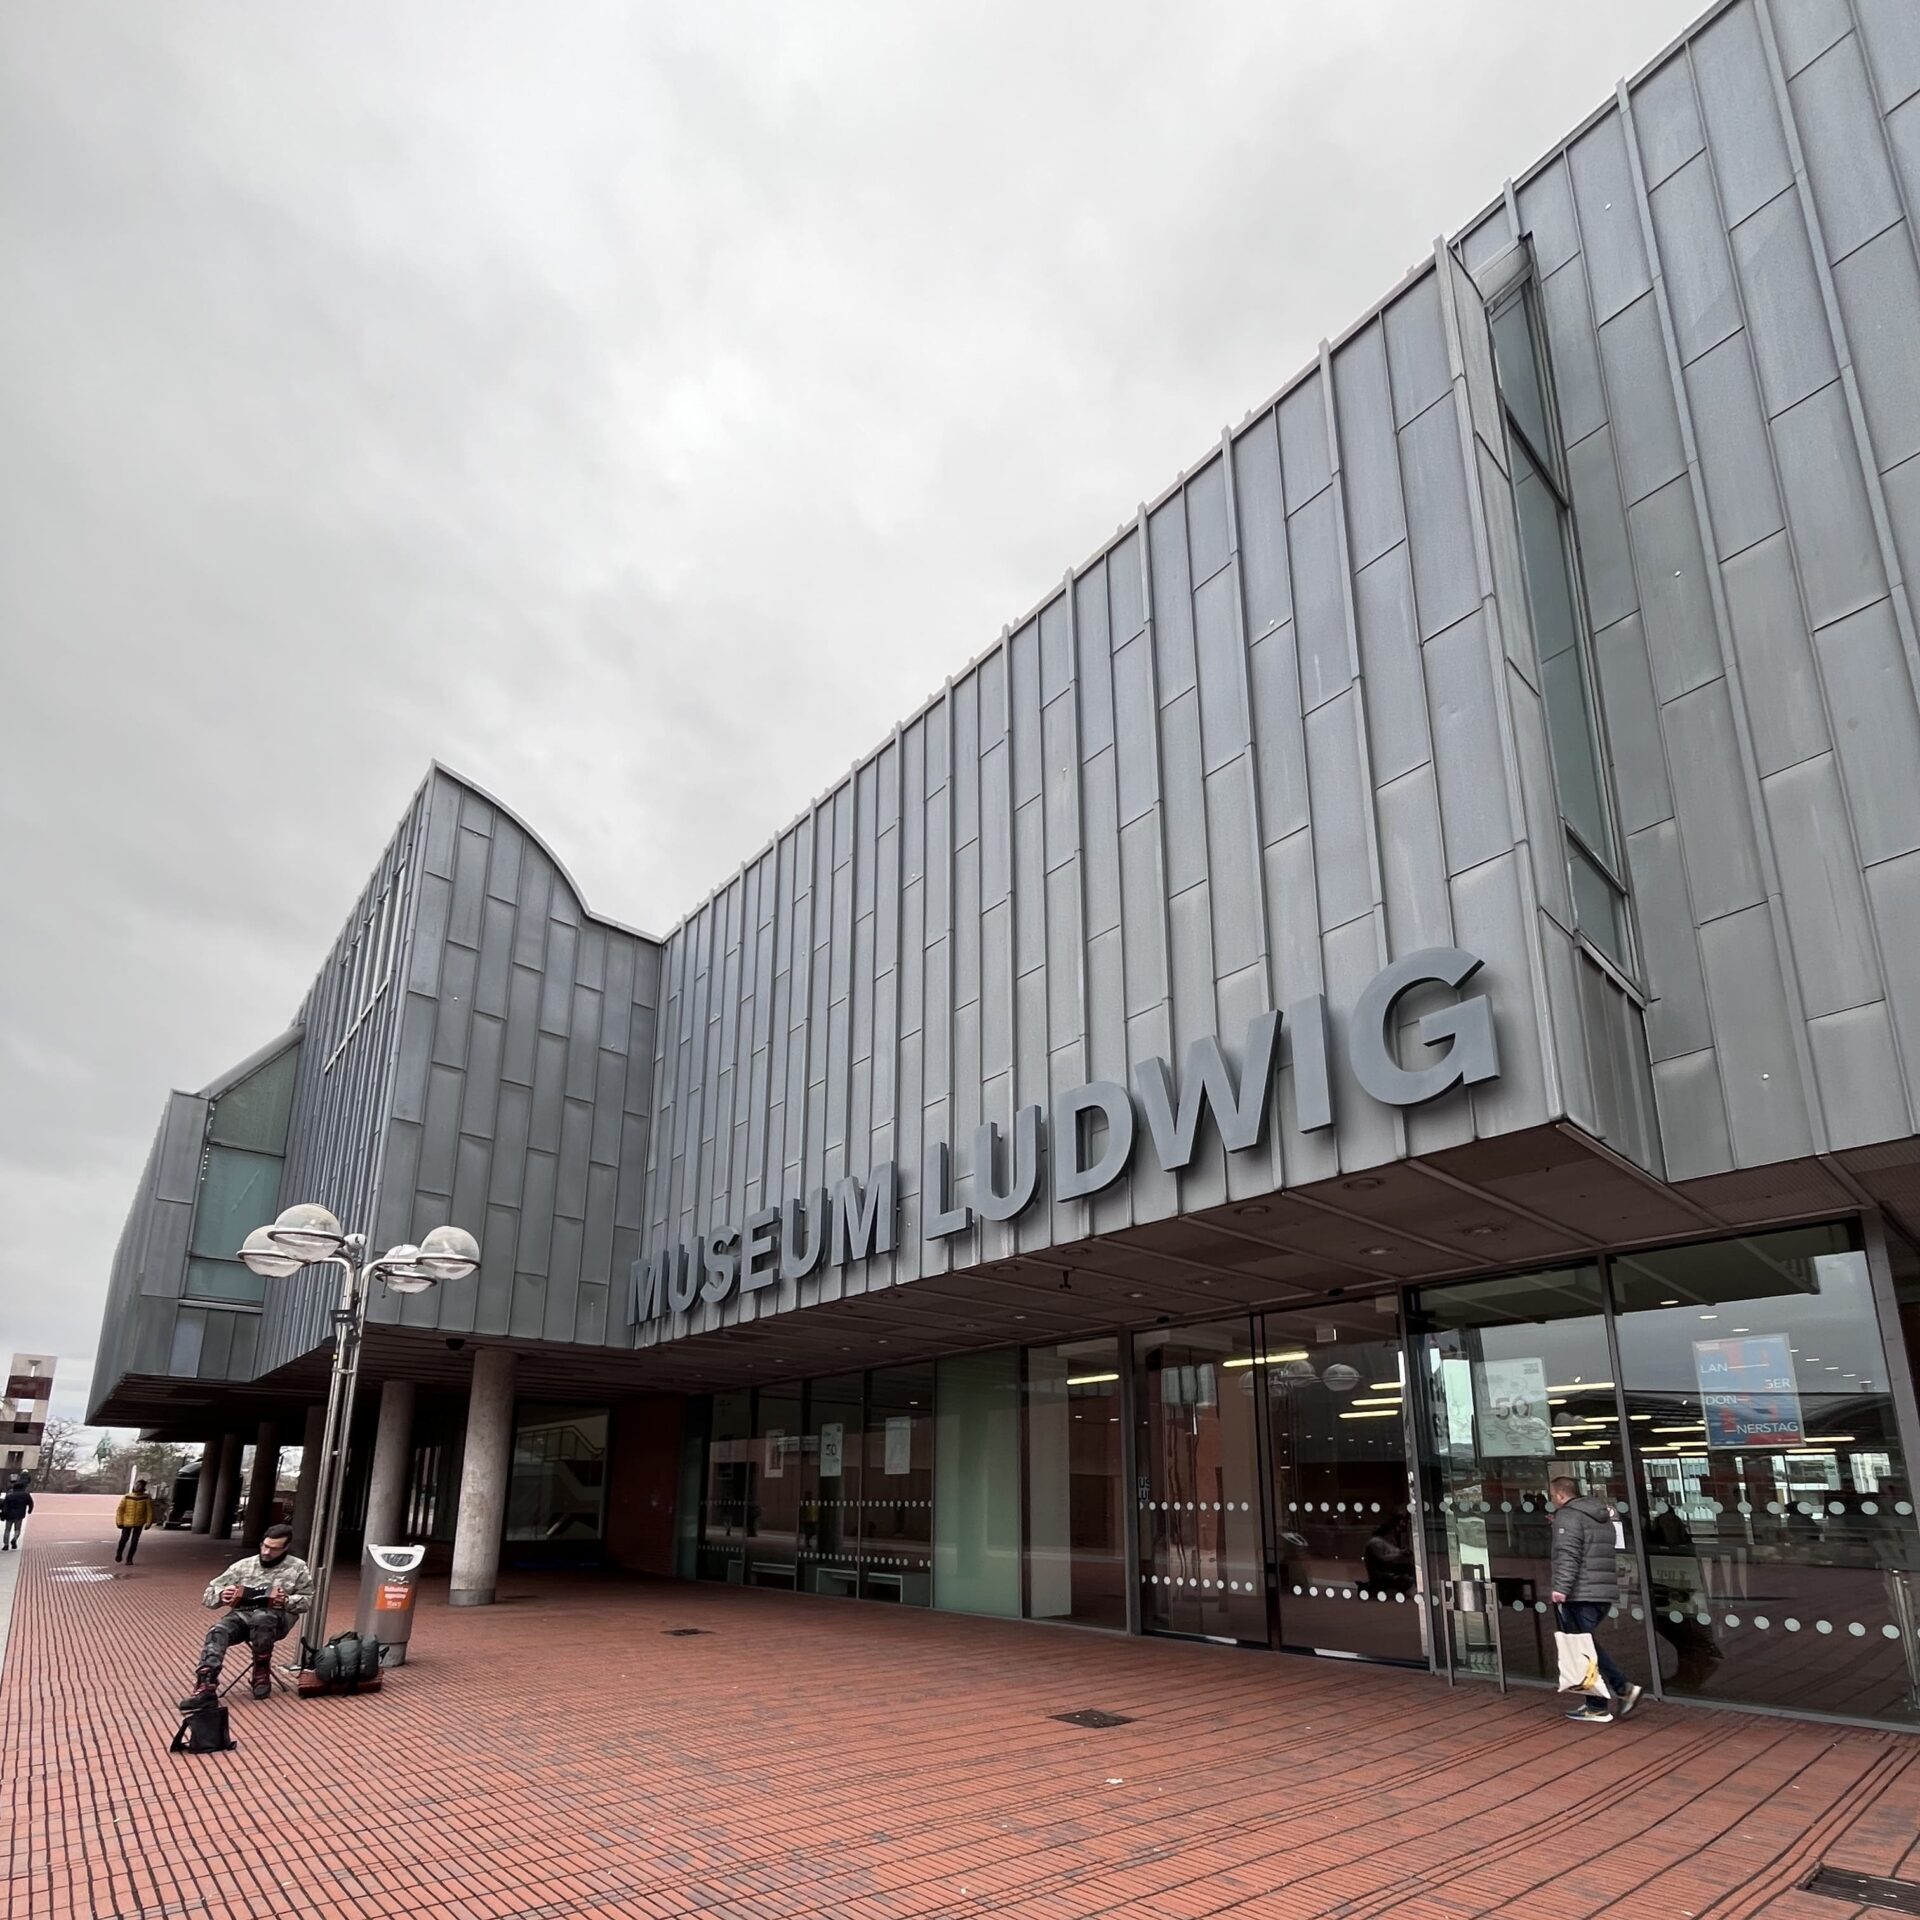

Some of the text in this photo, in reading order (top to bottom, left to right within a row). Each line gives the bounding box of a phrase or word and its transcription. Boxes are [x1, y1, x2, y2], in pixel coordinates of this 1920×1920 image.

[626, 946, 1501, 1327] MUSEUM LUDWIG
[1495, 1396, 1532, 1420] 50
